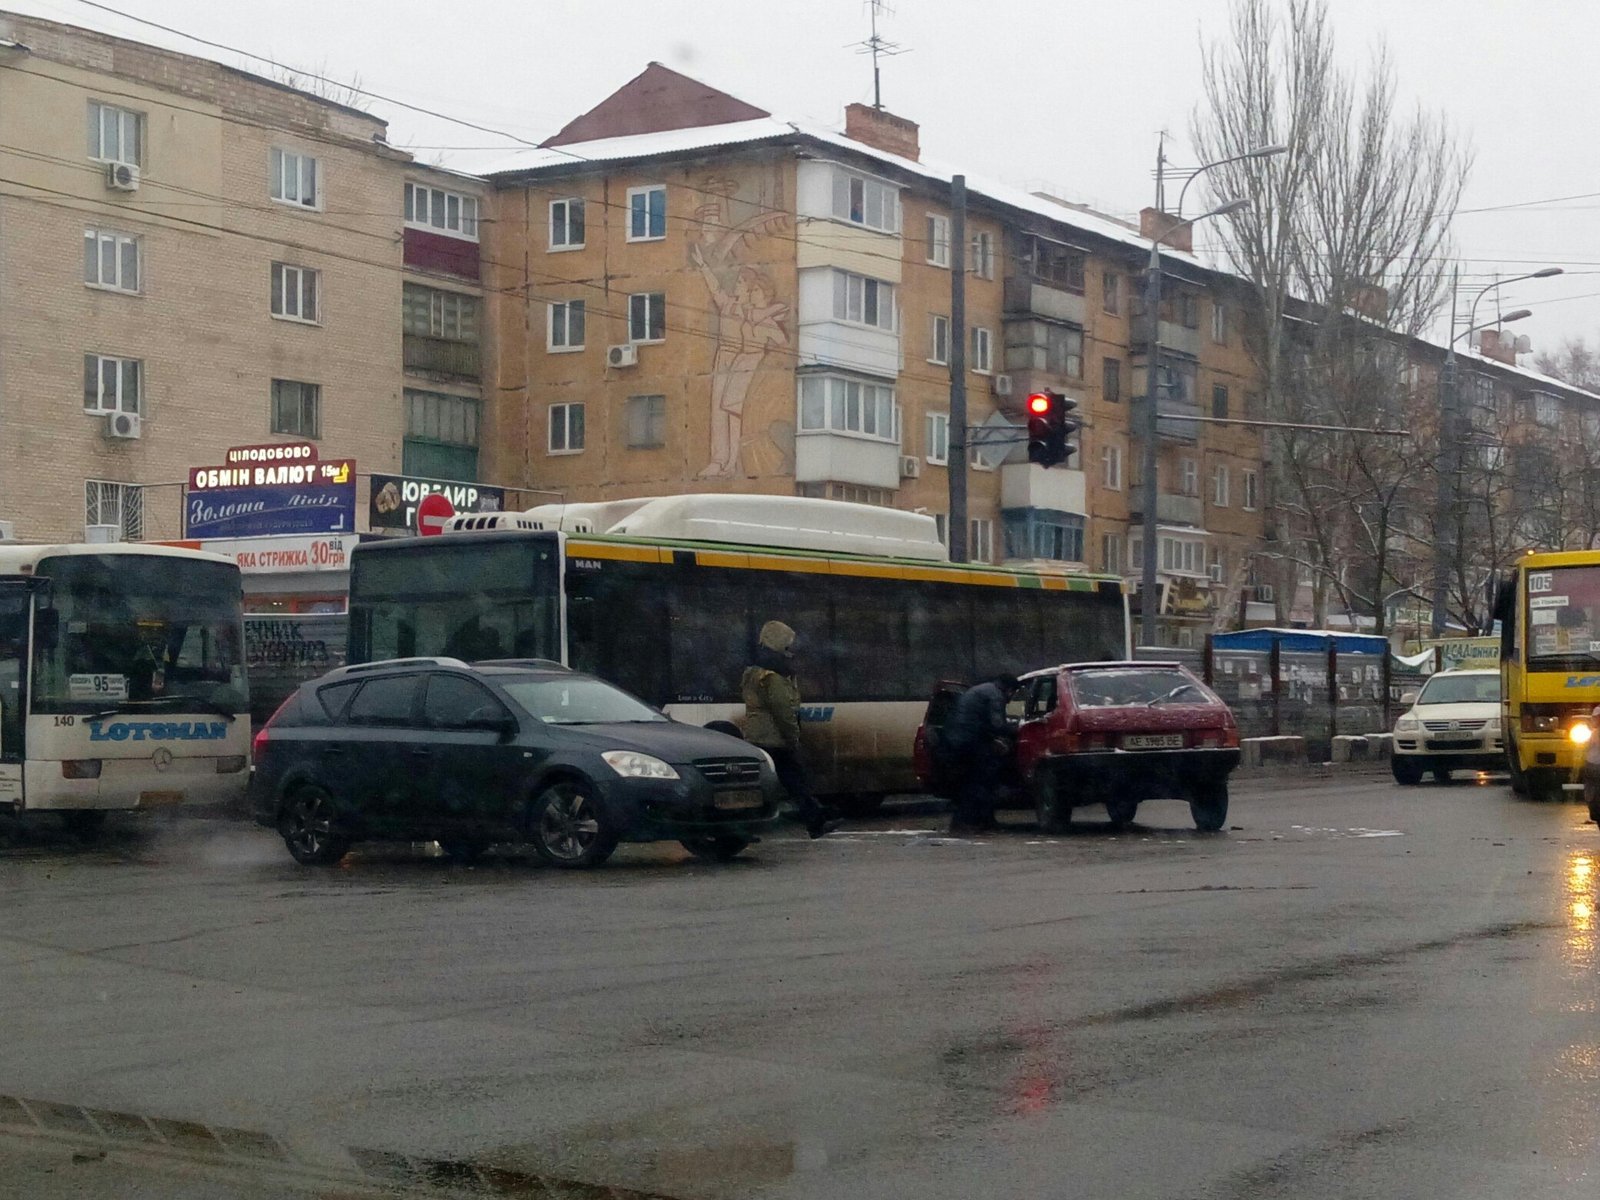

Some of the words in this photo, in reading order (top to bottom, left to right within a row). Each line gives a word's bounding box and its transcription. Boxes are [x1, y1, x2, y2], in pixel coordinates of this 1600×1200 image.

[229, 446, 311, 462] ЦІЛОДОБОВО
[196, 469, 250, 488] ОБМІН
[254, 465, 316, 485] ВАЛЮТ
[402, 481, 478, 507] ЮВЛИР
[190, 500, 265, 524] Золота
[259, 550, 308, 567] СТРИЖКА
[311, 541, 328, 564] 30
[328, 552, 345, 567] грн
[575, 559, 602, 569] MAN
[1530, 576, 1552, 591] 105
[94, 676, 109, 692] 95
[54, 716, 75, 727] 140
[90, 721, 227, 741] LOTSMAN
